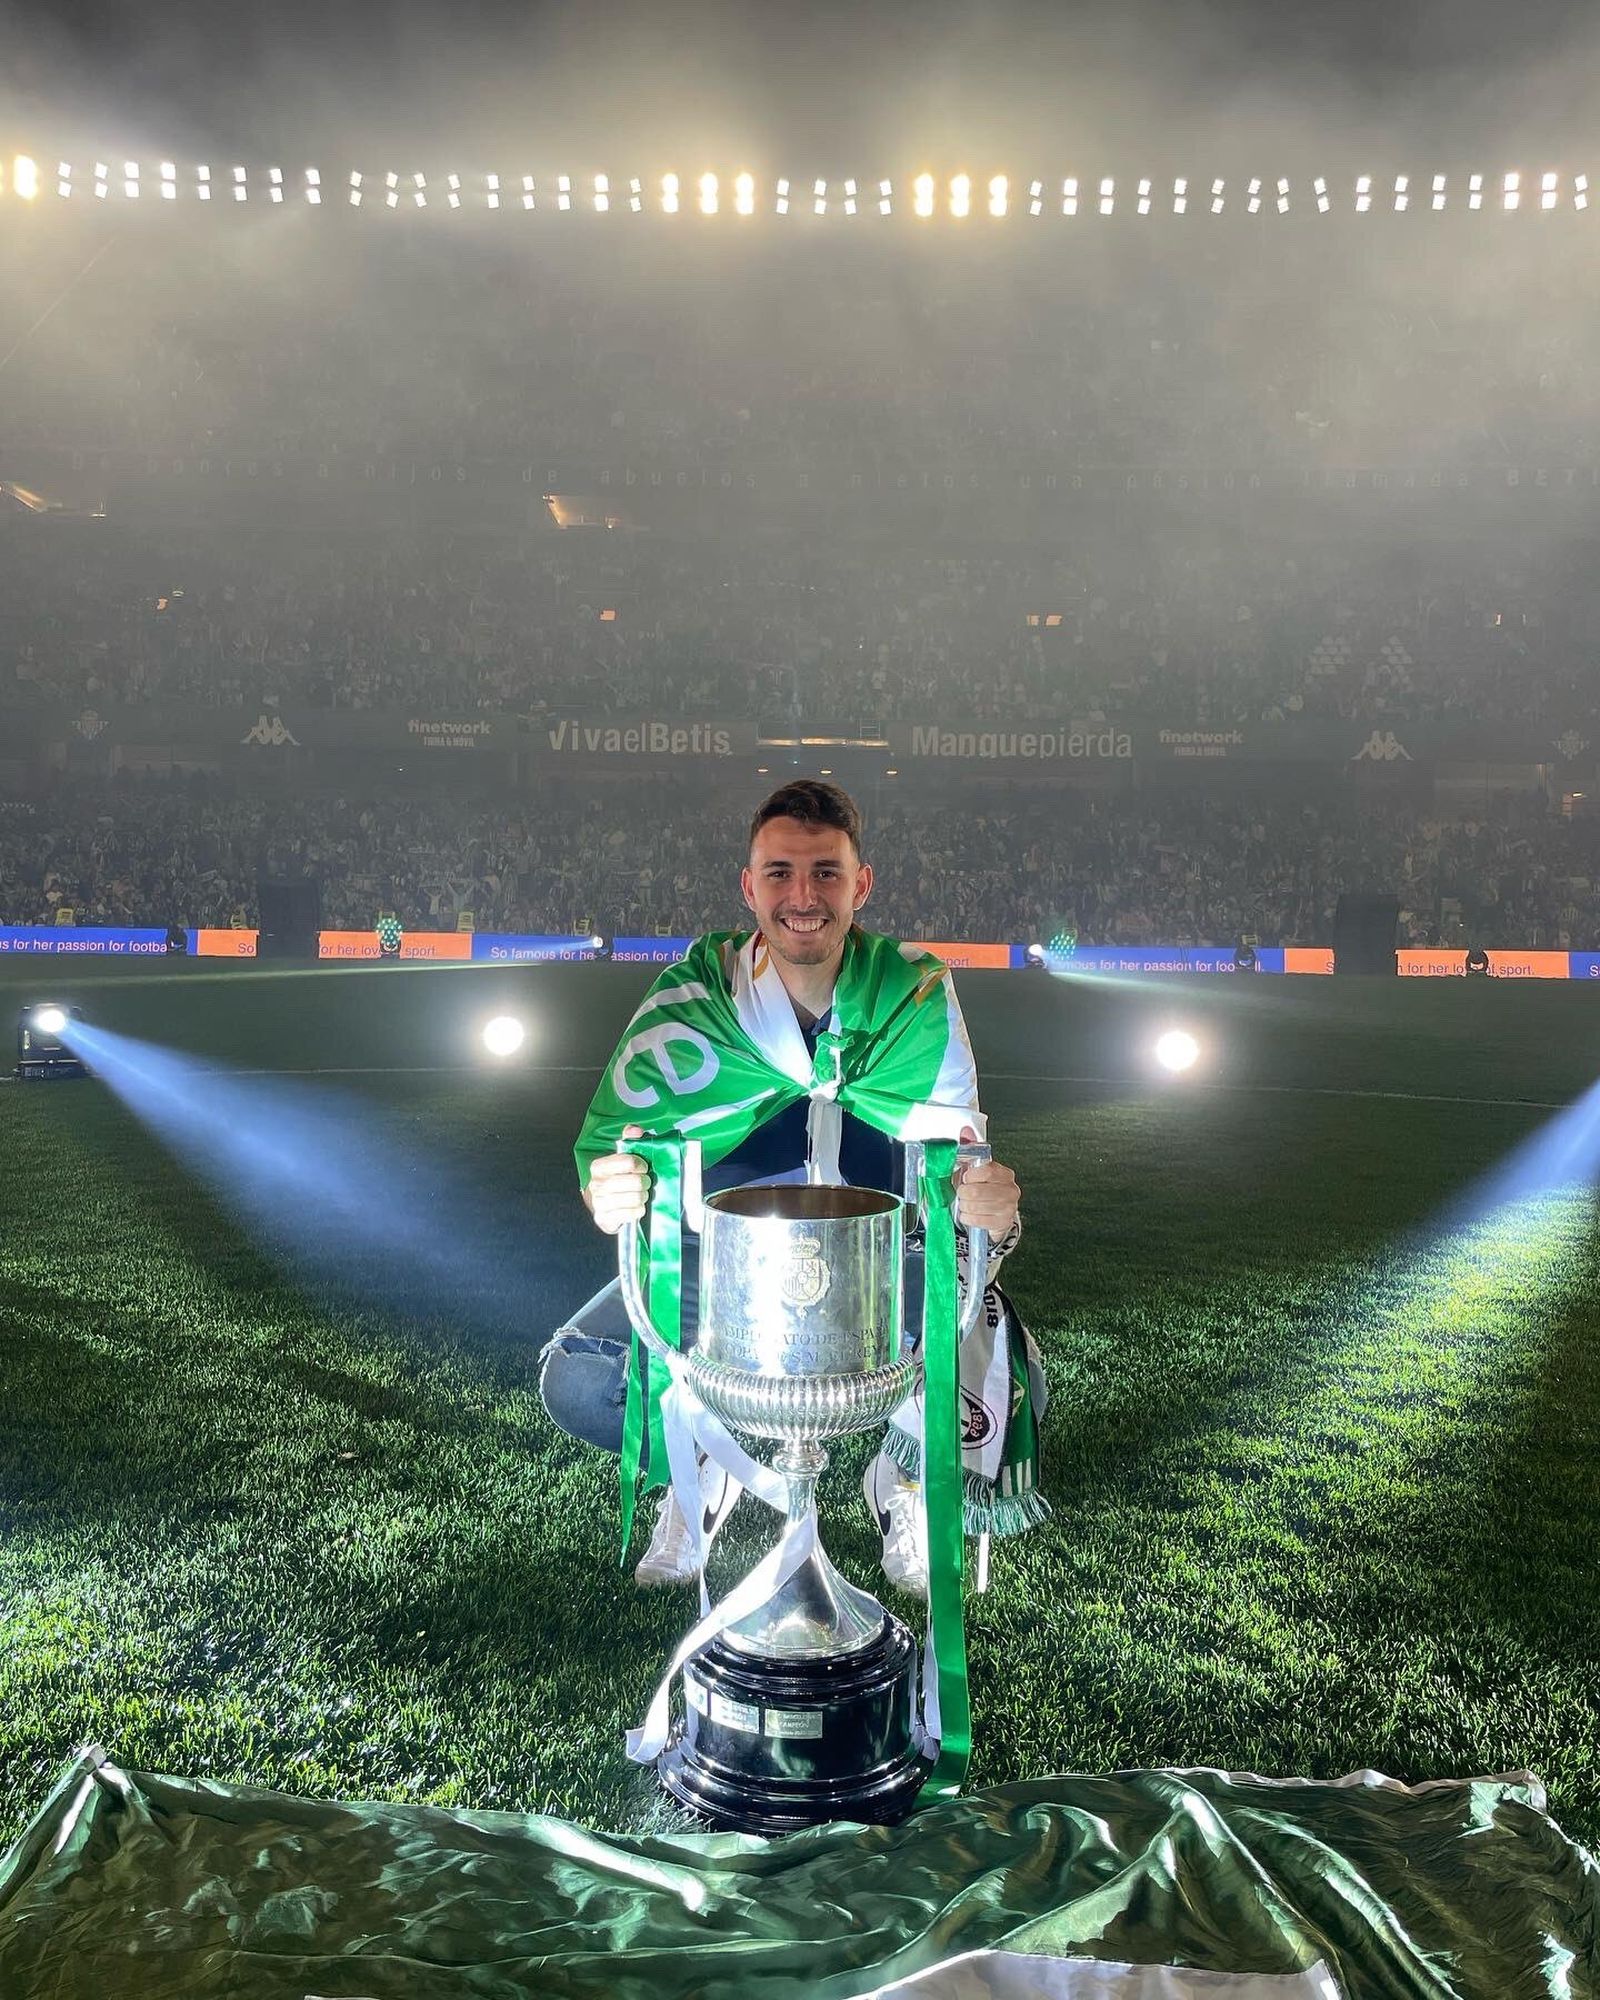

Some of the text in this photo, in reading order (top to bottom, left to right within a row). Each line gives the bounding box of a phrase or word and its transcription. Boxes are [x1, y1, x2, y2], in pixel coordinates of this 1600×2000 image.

[1508, 467, 1600, 488] BETI
[407, 719, 491, 734] finetwork
[549, 720, 731, 754] VivaelBetis
[911, 725, 1133, 759] Manquepierda
[1159, 728, 1243, 744] finetwork
[13, 939, 30, 950] for
[33, 938, 54, 950] her
[57, 939, 105, 953] passion
[109, 940, 125, 952] for
[129, 940, 168, 953] footba
[238, 943, 255, 954] So
[321, 944, 381, 955] or her lov
[490, 946, 594, 960] So famous for he
[611, 950, 649, 961] assion
[653, 950, 670, 961] for
[1100, 960, 1116, 970] for
[1120, 960, 1140, 971] her
[1144, 960, 1192, 973] passion
[1196, 960, 1213, 972] for
[1407, 963, 1424, 974] for
[1428, 963, 1448, 974] her
